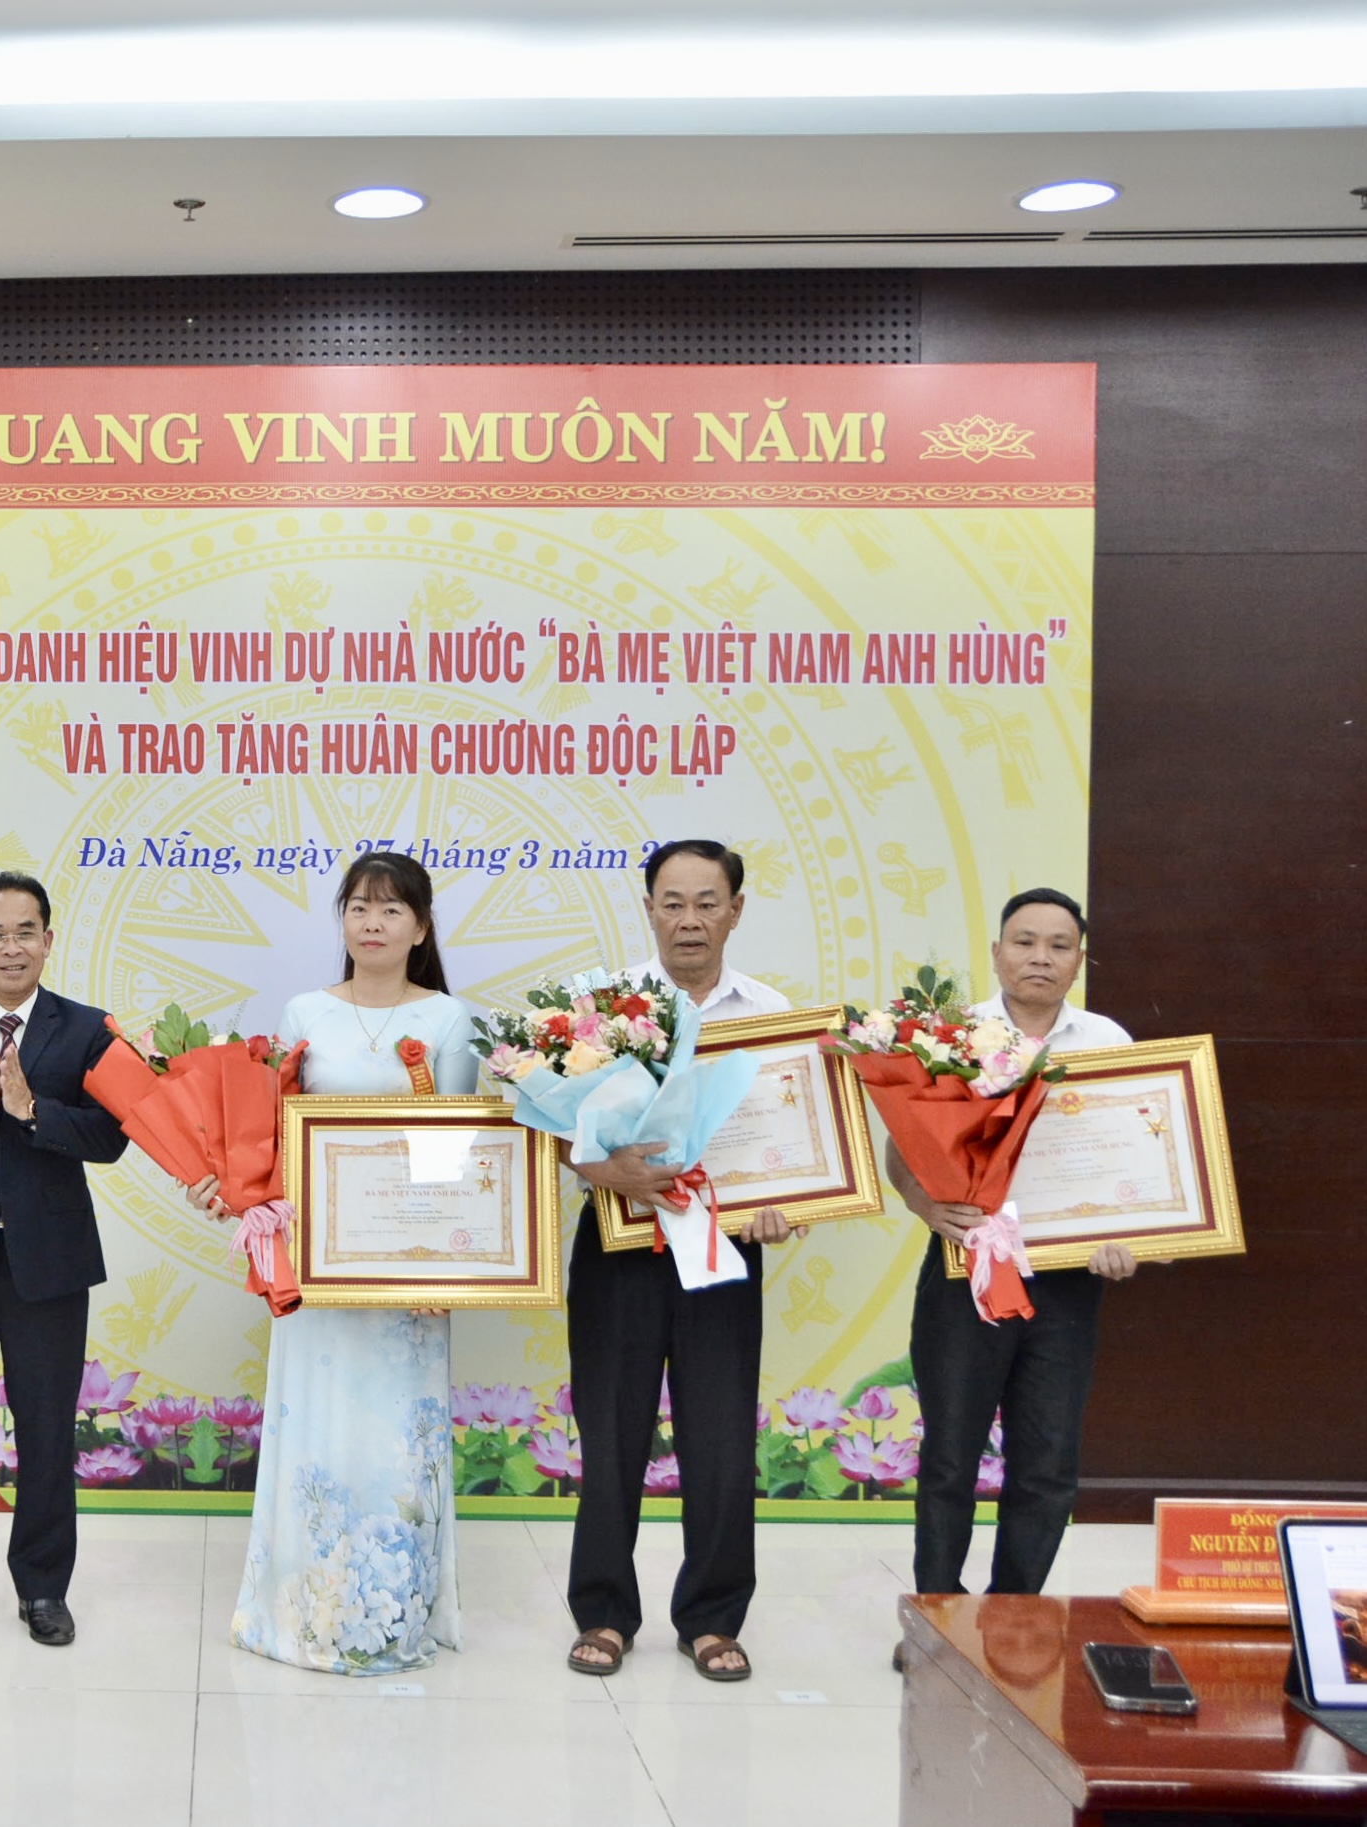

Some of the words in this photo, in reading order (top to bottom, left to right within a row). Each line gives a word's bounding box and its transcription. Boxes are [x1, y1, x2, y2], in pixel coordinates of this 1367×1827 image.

[224, 411, 417, 465] VINH
[439, 396, 674, 464] MUÔN
[694, 394, 888, 464] NĂM!
[99, 622, 178, 694] HIỆU
[190, 632, 272, 682] VINH
[286, 629, 334, 694] DỰ
[344, 622, 416, 683] NHÀ
[429, 620, 525, 684] NƯỚC
[618, 633, 670, 695] MẸ
[683, 622, 756, 695] VIỆT
[769, 633, 851, 684] NAM
[863, 634, 936, 684] ANH
[63, 713, 107, 774] VÀ
[118, 723, 205, 774] TRAO
[217, 713, 309, 786] TẶNG
[322, 713, 418, 774] HUÂN
[431, 719, 575, 775] CHƯƠNG
[588, 714, 658, 787] ĐỘC
[671, 714, 736, 787] LẬP
[78, 838, 126, 868] Đà
[138, 830, 242, 875] Nẵng,
[255, 839, 342, 875] ngày
[404, 838, 512, 876] tháng
[518, 840, 540, 869] 3
[549, 840, 628, 869] năm
[1189, 1527, 1260, 1552] NGUYỄN
